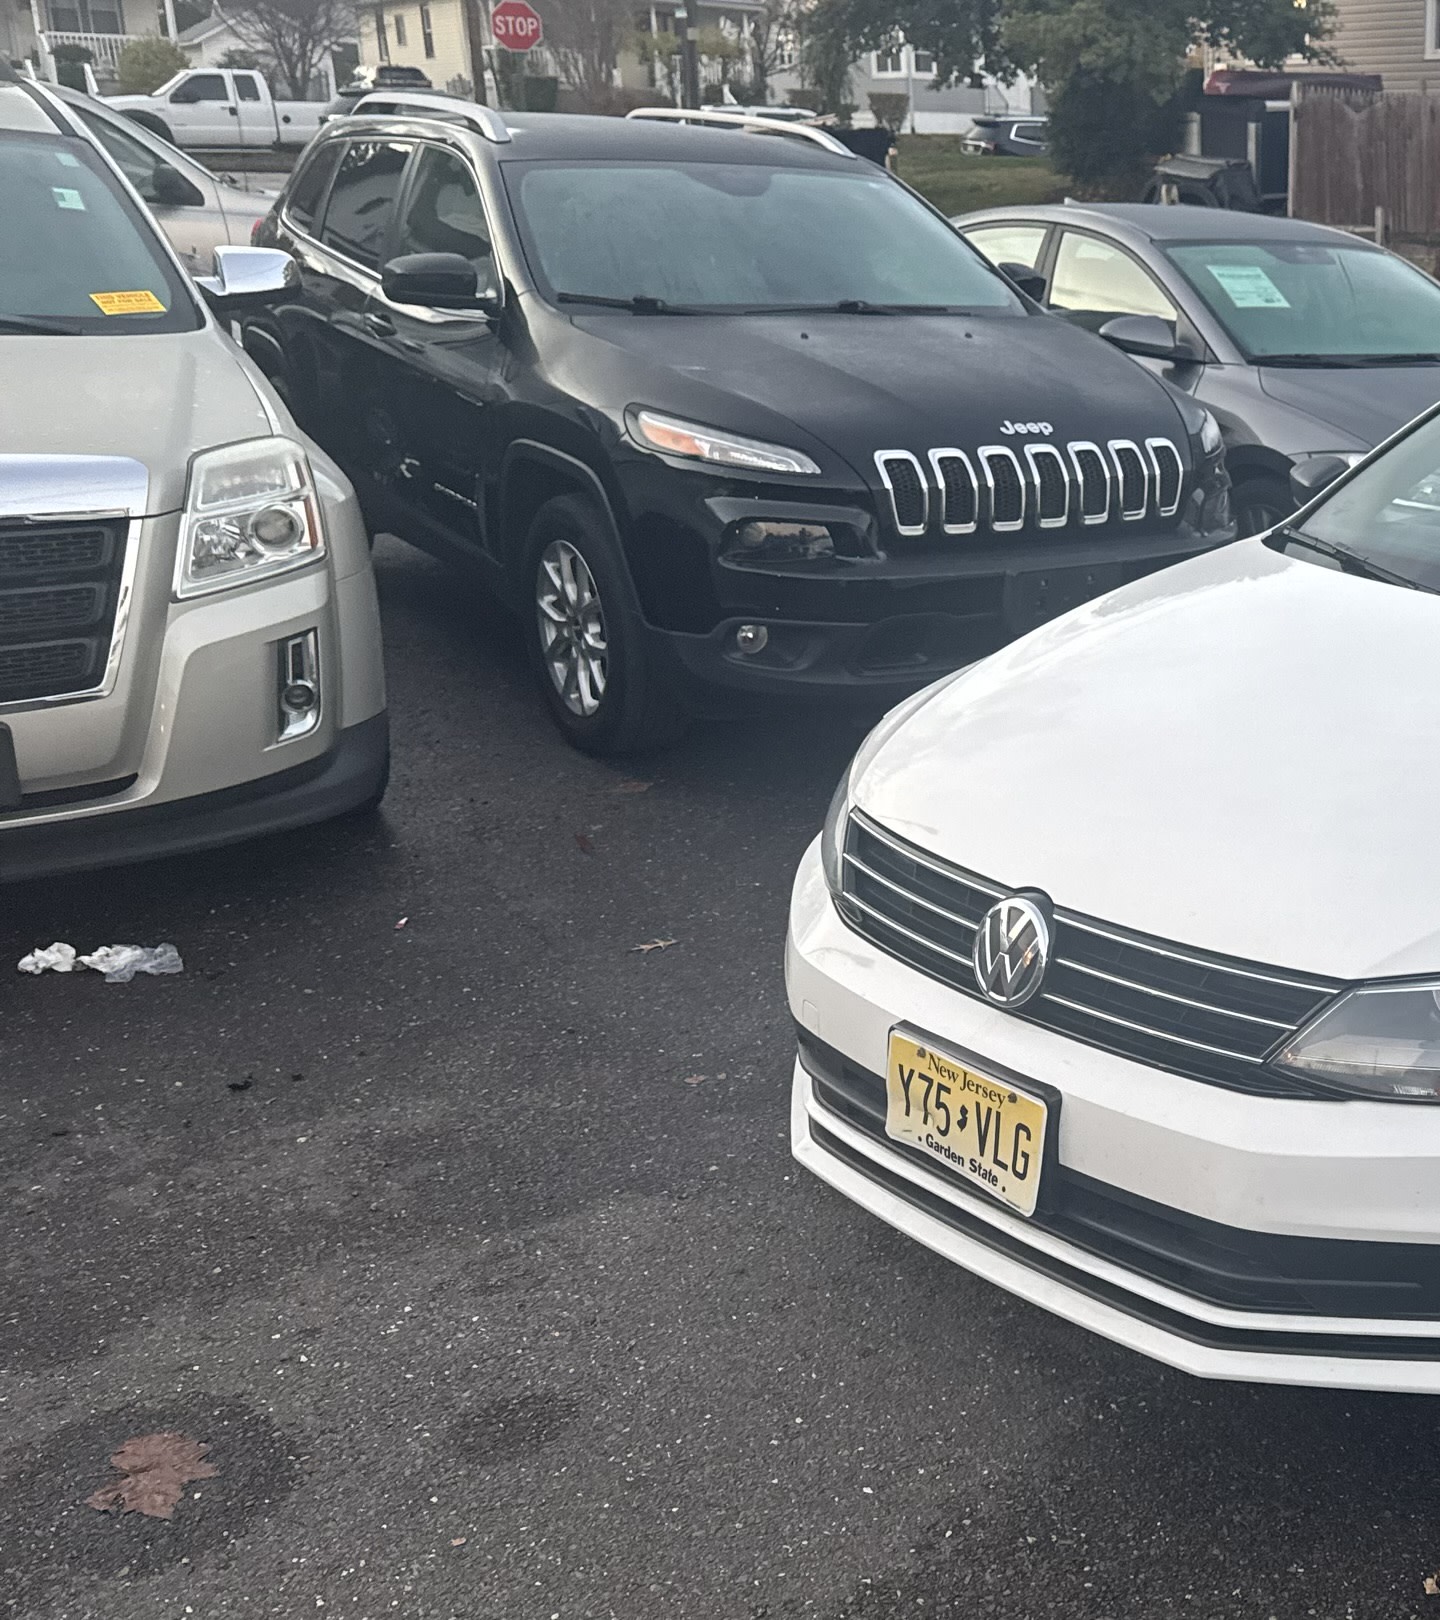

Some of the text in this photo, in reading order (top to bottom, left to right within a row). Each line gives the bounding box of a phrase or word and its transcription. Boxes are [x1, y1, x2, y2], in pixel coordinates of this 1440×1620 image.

[495, 15, 538, 36] STOP
[1000, 420, 1053, 435] Jeep
[928, 1053, 1007, 1108] New Jersey
[898, 1063, 1031, 1181] Y75 VLG
[926, 1133, 998, 1187] Garden State
